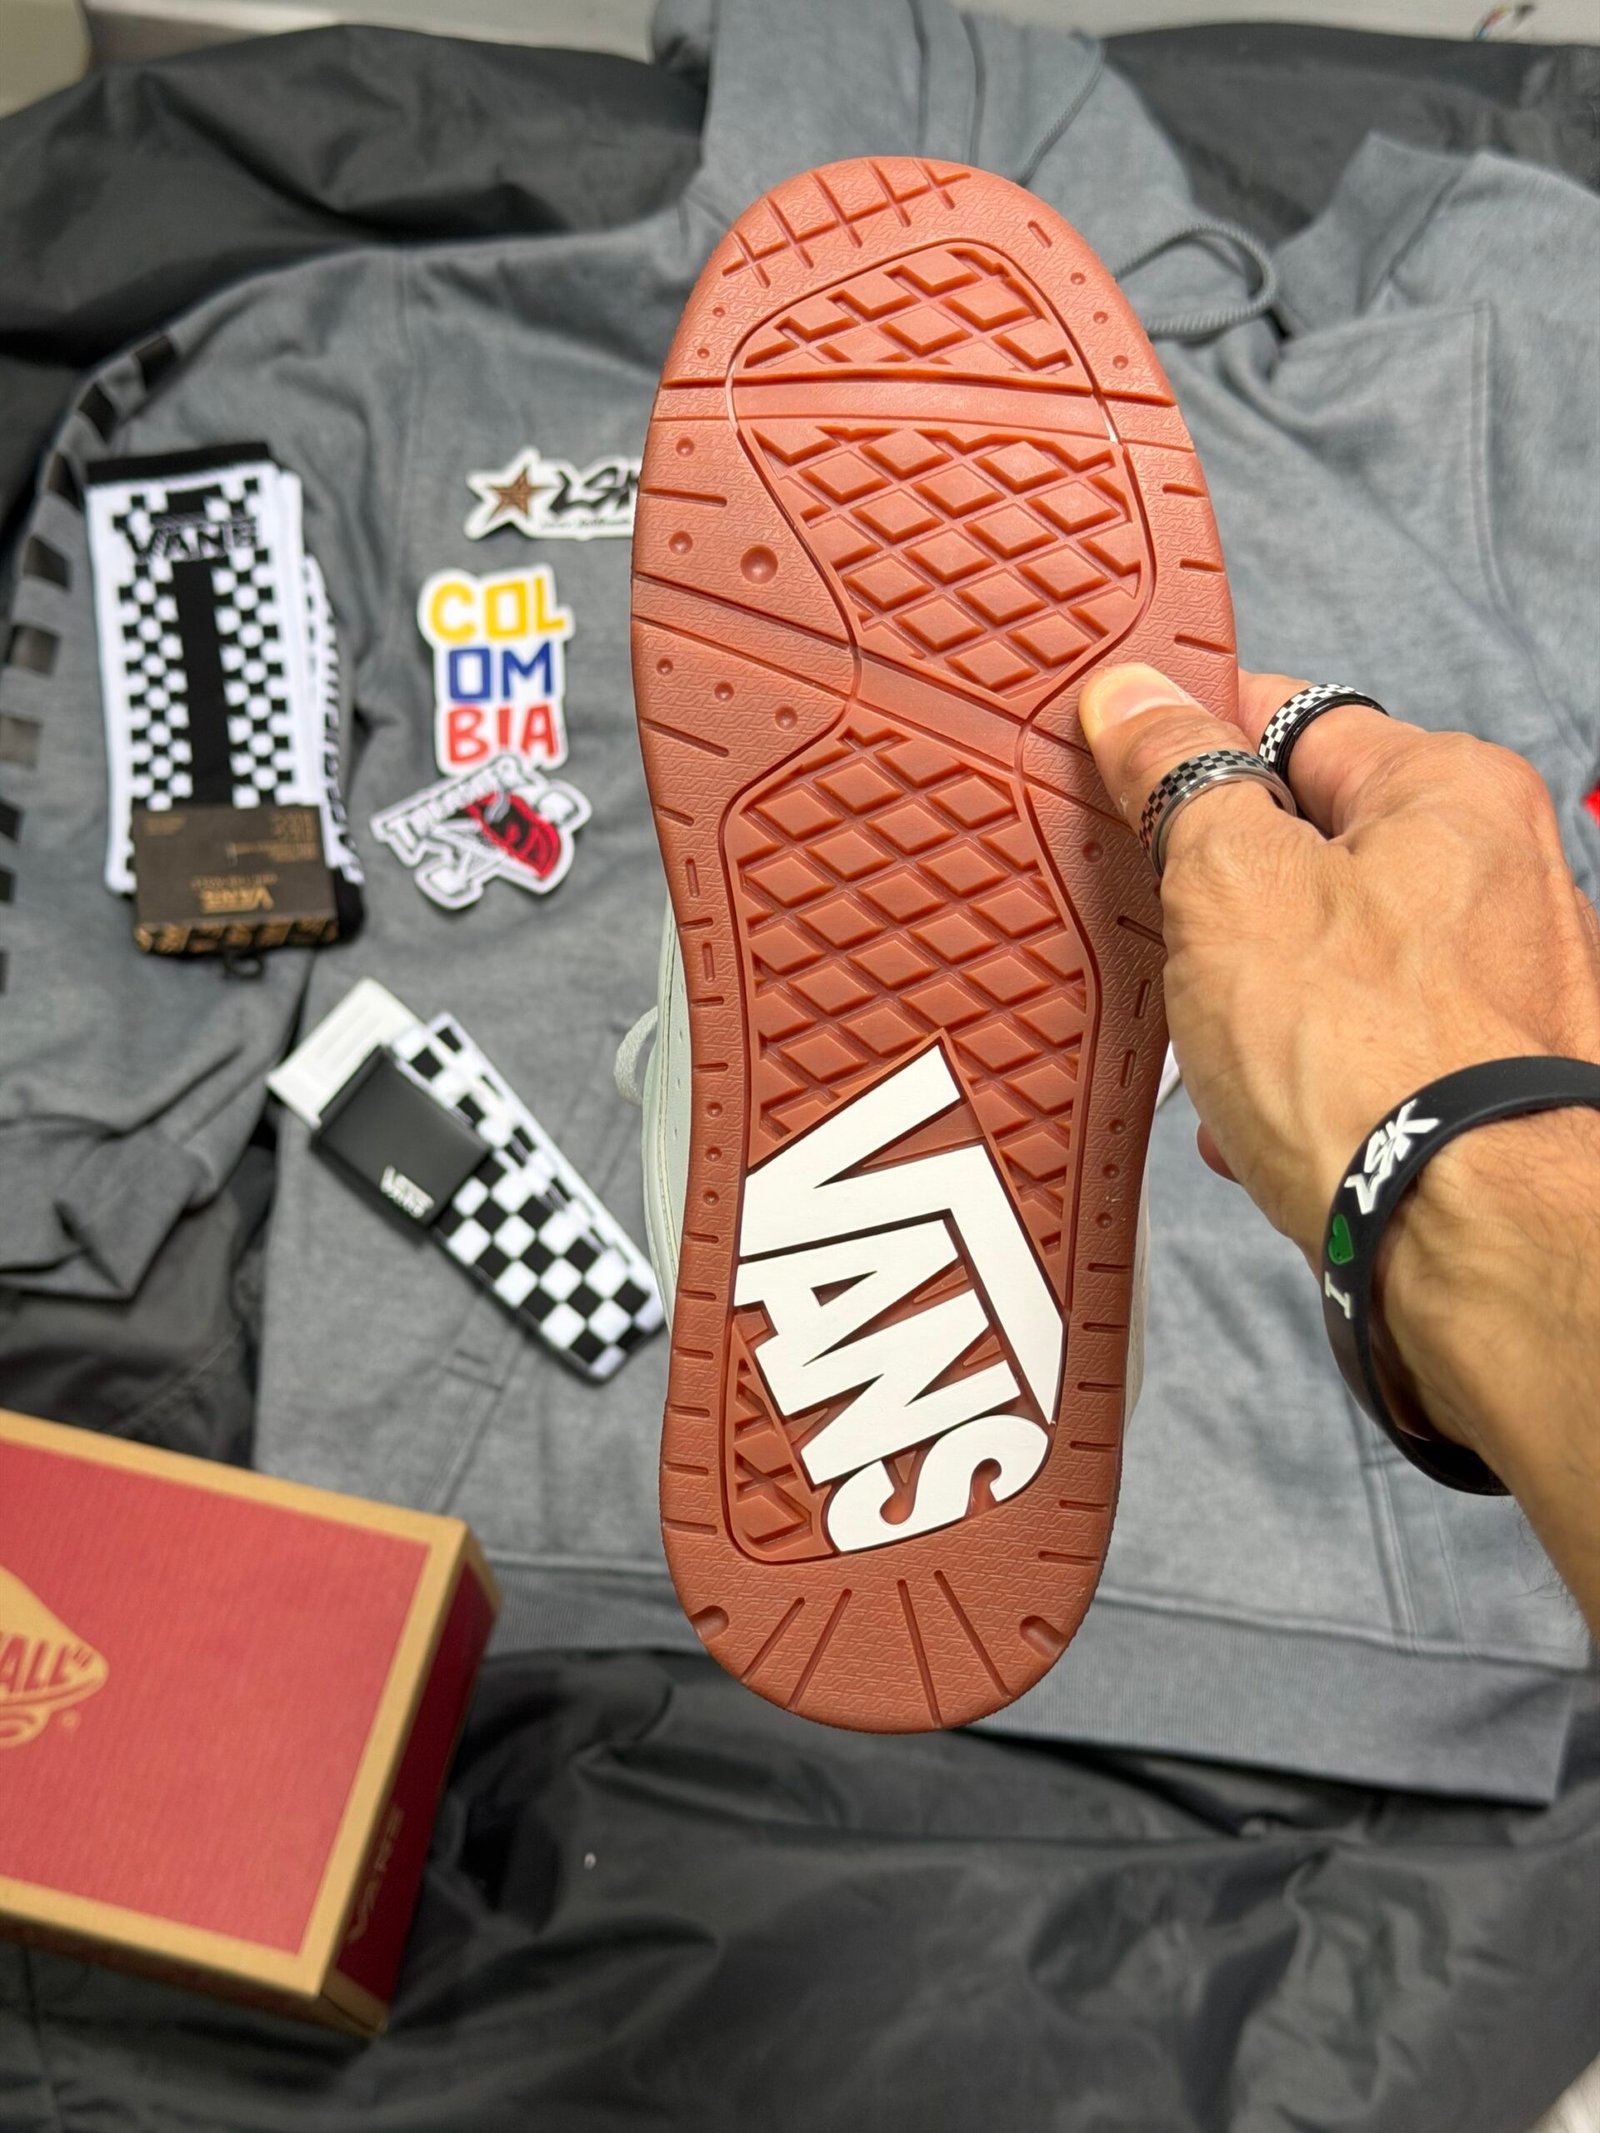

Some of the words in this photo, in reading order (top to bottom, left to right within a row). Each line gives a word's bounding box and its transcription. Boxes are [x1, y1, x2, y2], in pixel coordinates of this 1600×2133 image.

[429, 576, 567, 643] COL
[447, 641, 554, 704] OM
[446, 704, 560, 766] BIA
[733, 1044, 1064, 1553] VANS
